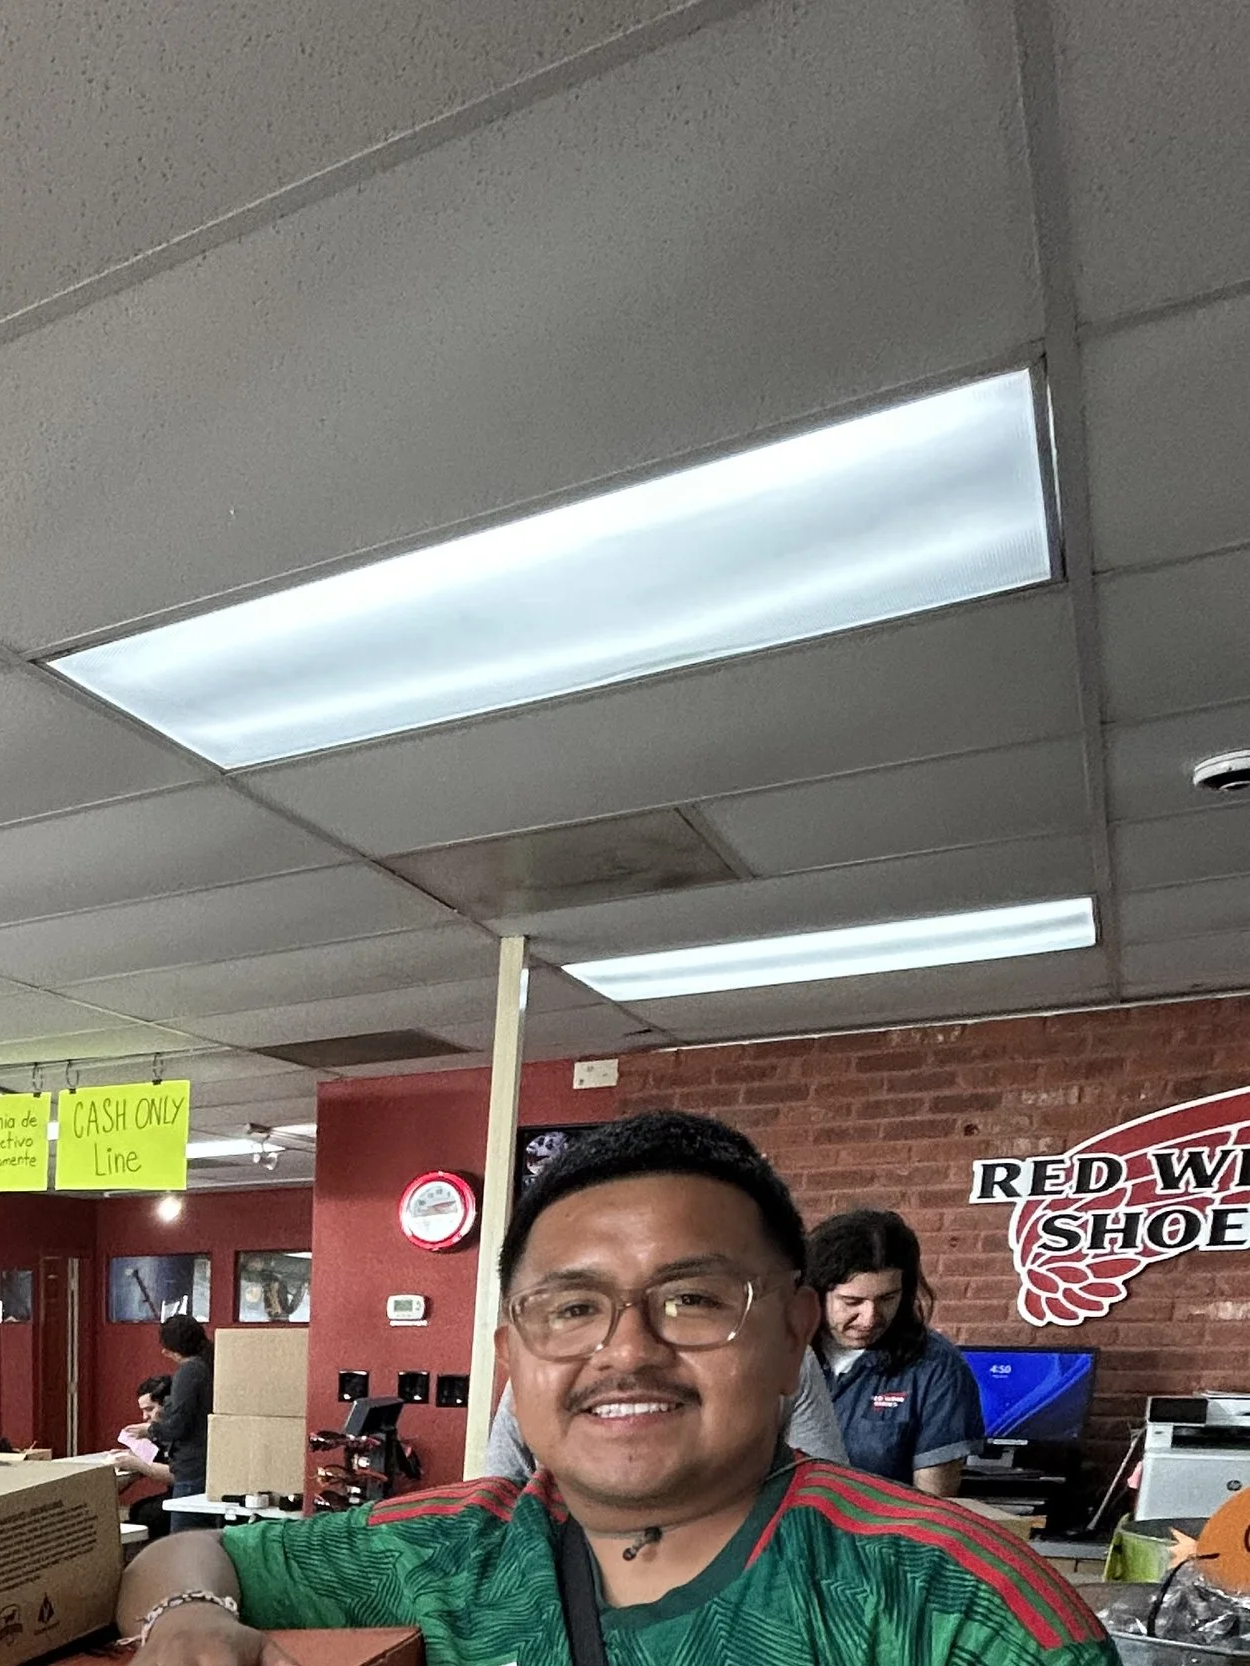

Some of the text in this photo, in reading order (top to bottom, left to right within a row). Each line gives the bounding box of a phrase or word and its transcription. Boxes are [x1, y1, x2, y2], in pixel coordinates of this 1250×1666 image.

[22, 1110, 38, 1128] de
[73, 1096, 185, 1138] CASH ONLY
[95, 1143, 142, 1176] Line
[977, 1156, 1124, 1199] RED
